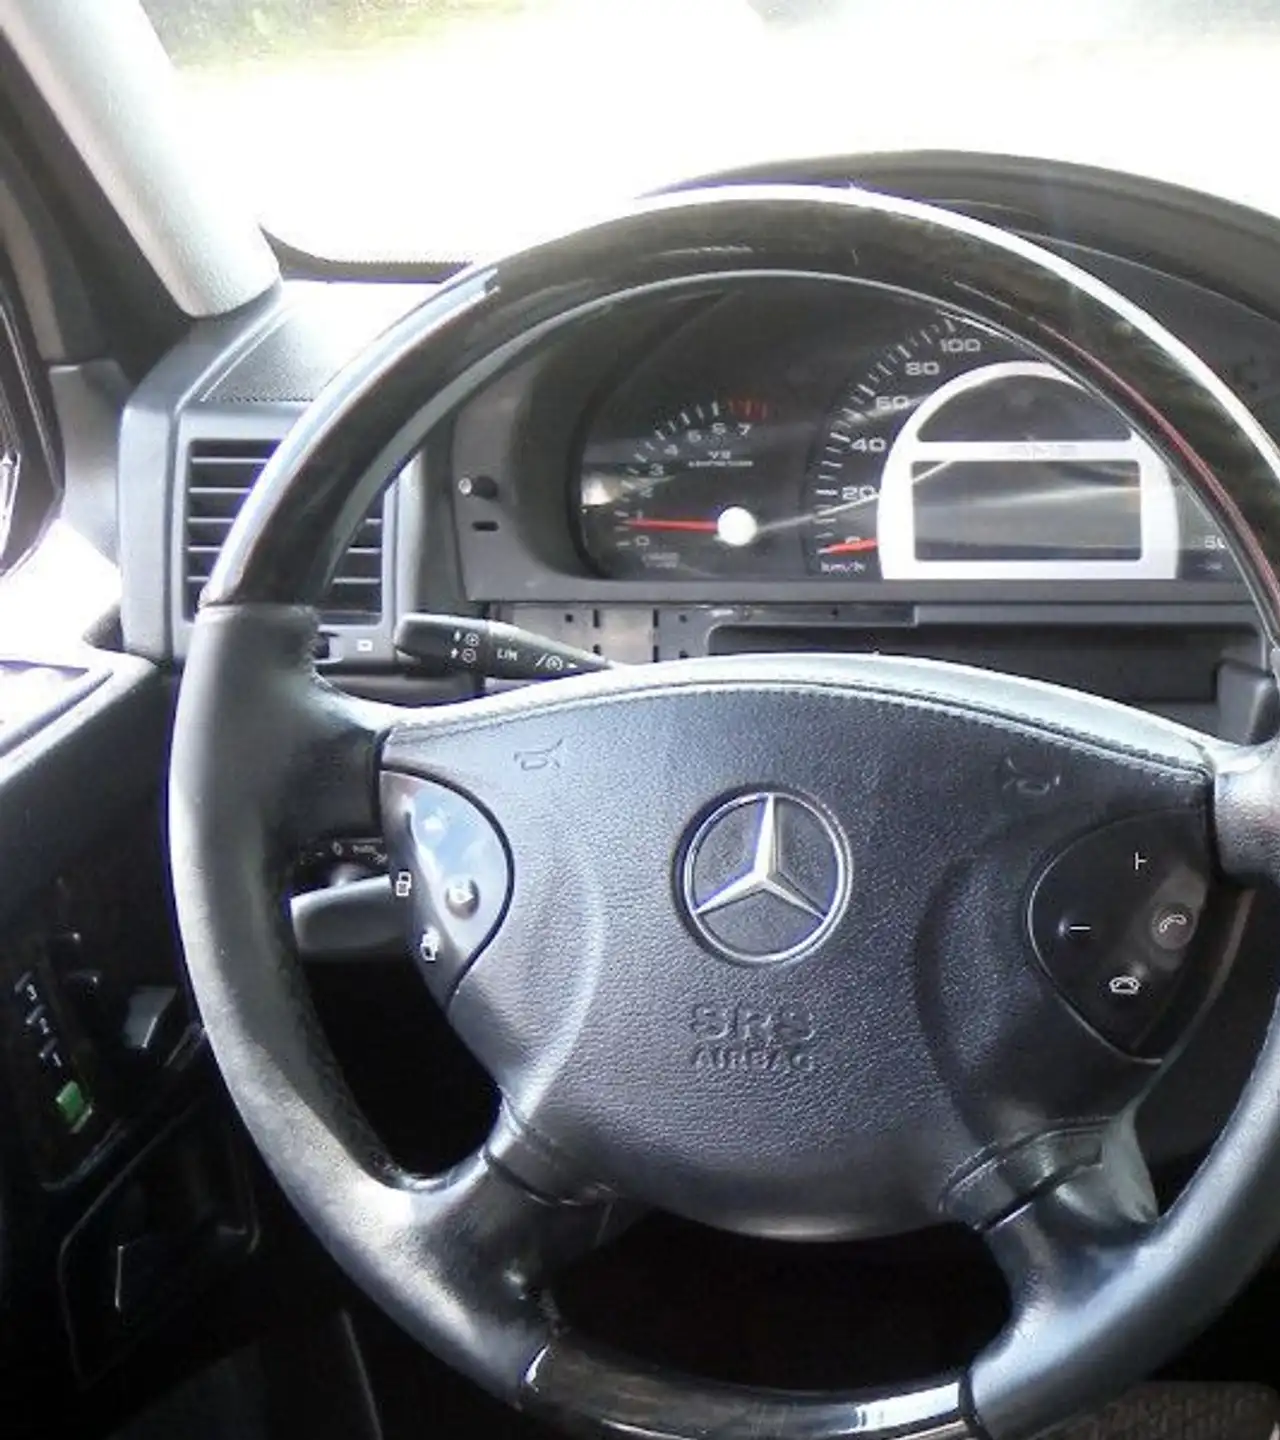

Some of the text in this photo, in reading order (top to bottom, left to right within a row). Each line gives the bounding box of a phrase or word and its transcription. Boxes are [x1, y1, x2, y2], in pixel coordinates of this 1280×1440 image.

[940, 338, 981, 354] 100
[905, 361, 940, 376] 80
[851, 438, 887, 453] 40
[842, 485, 876, 501] 20
[820, 562, 867, 575] km/h
